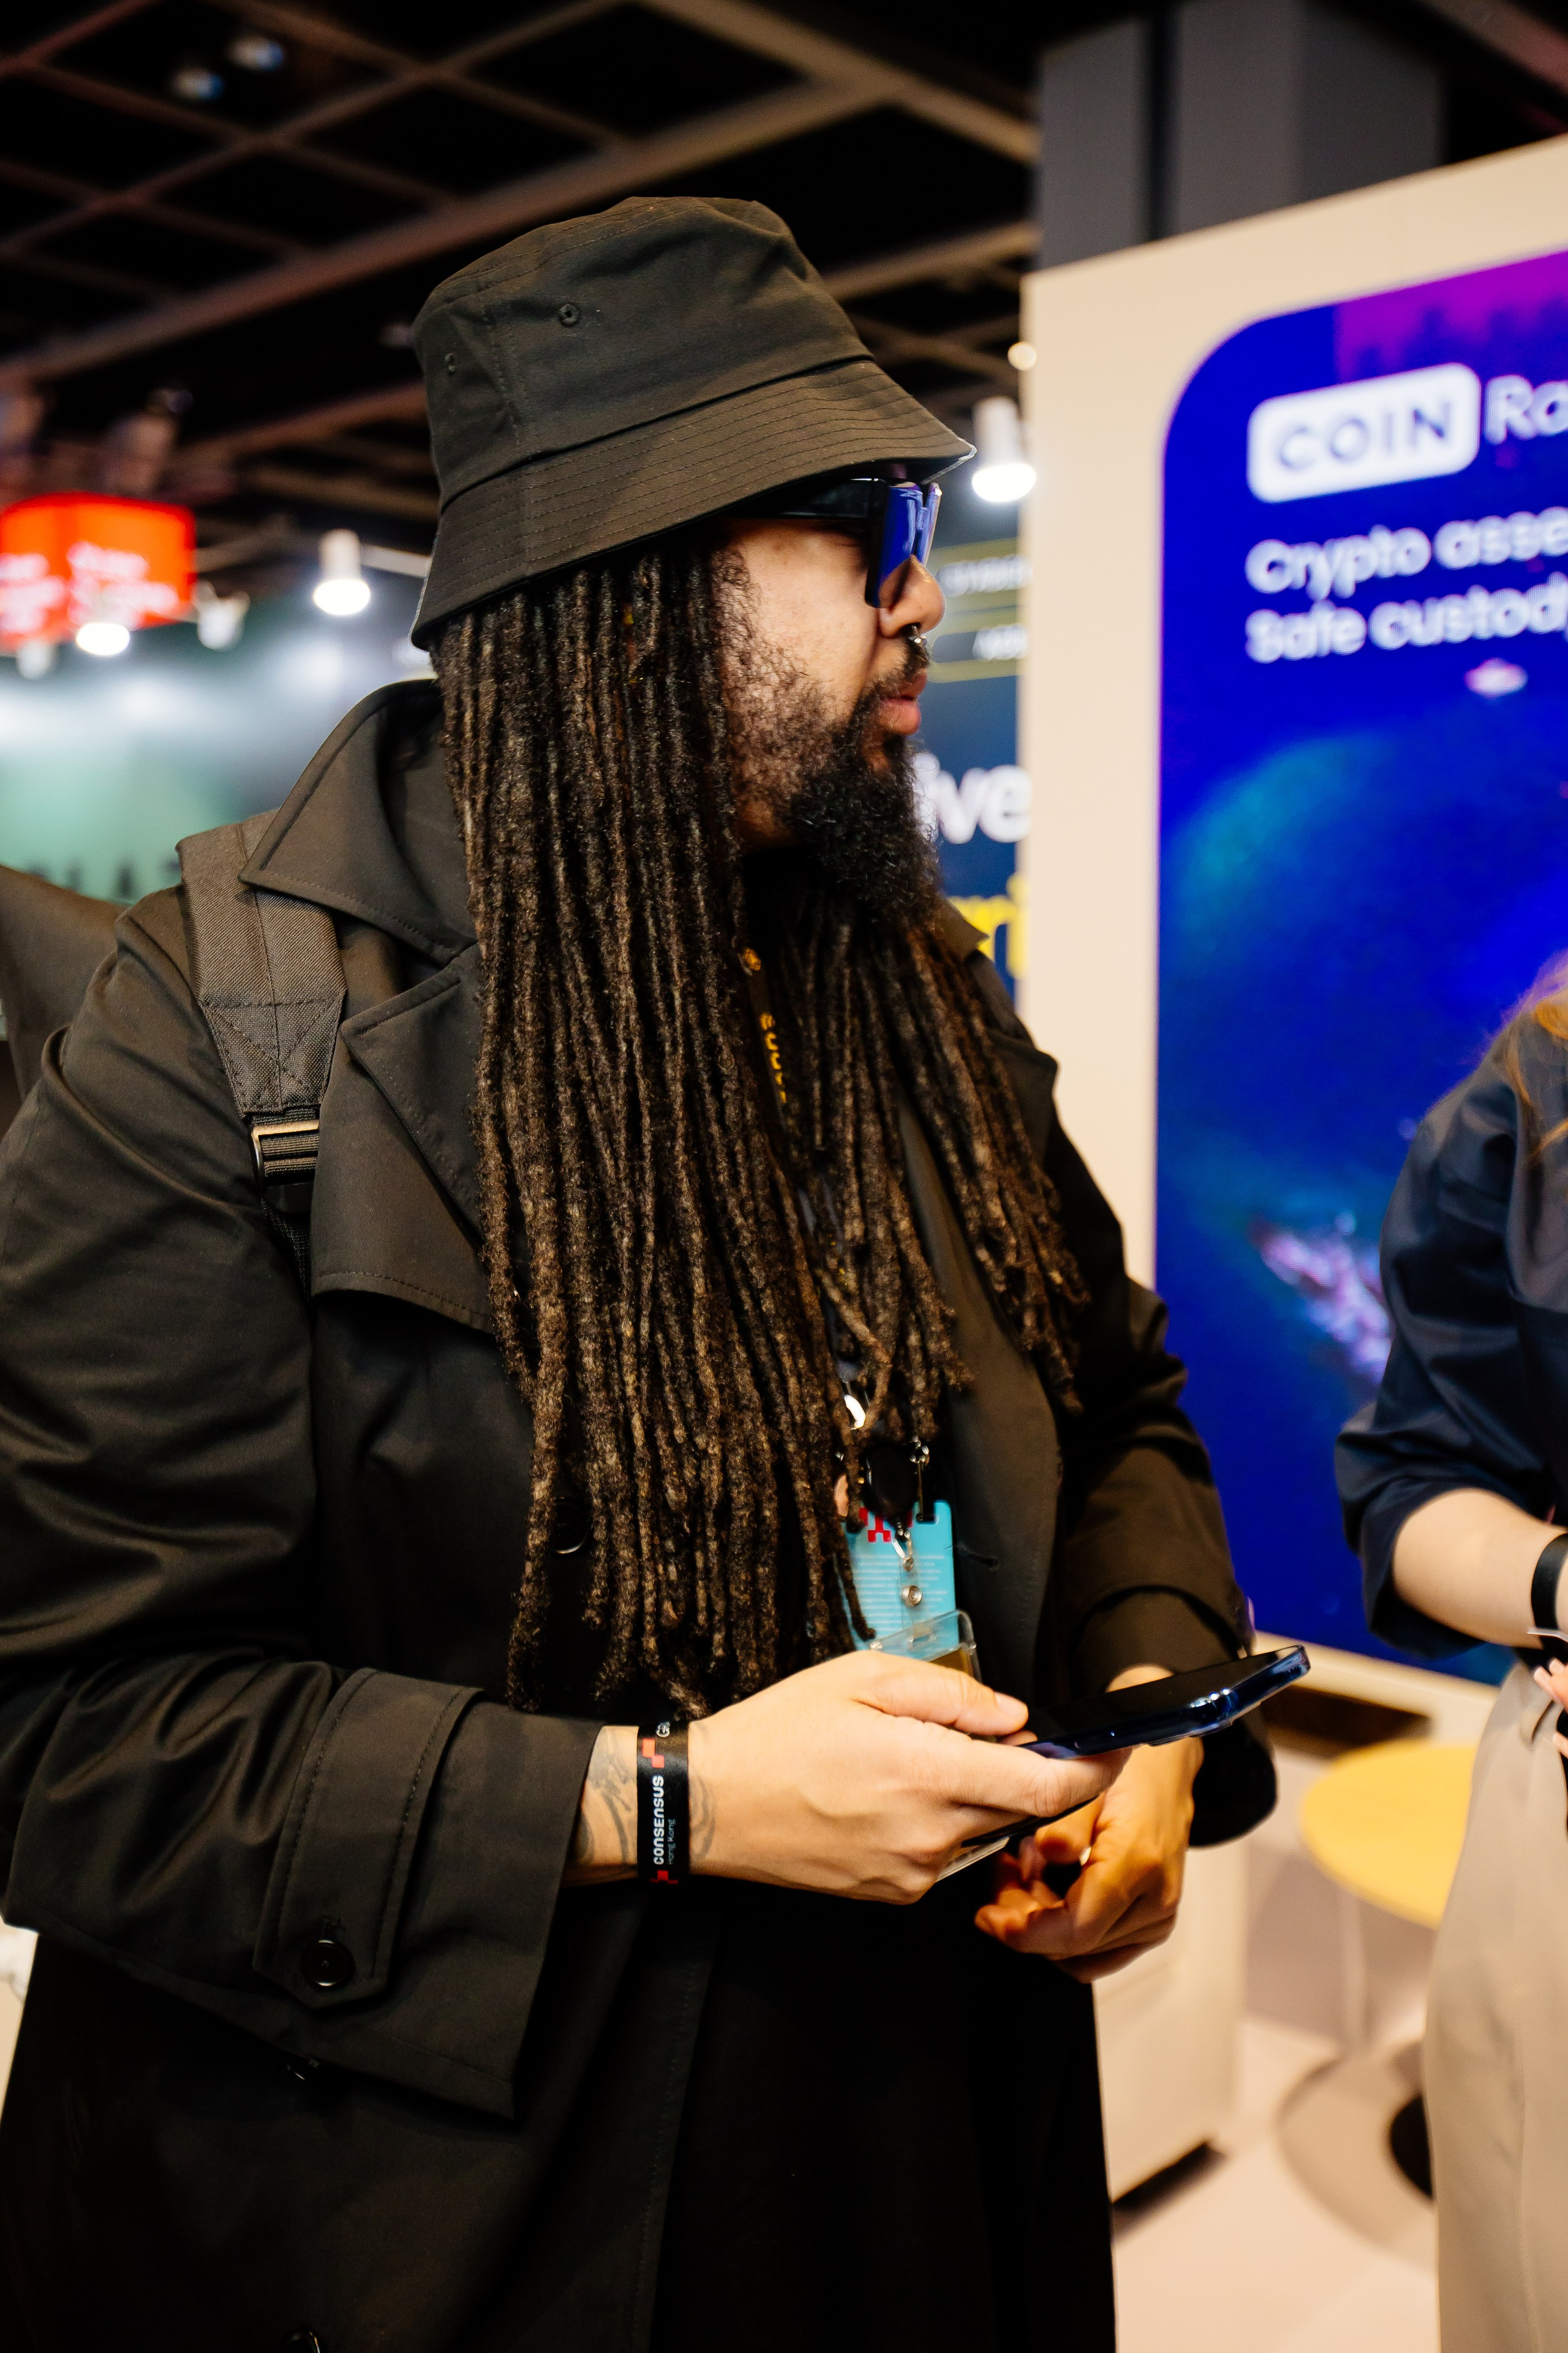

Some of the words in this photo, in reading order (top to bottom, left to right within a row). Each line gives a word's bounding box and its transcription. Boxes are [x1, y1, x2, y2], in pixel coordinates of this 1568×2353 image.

[1278, 397, 1452, 471] COIN
[1245, 524, 1431, 601] Crypto
[1245, 600, 1366, 664] Safe
[1368, 571, 1568, 651] custod
[668, 1819, 676, 1842] Kong
[668, 1843, 676, 1865] Hong
